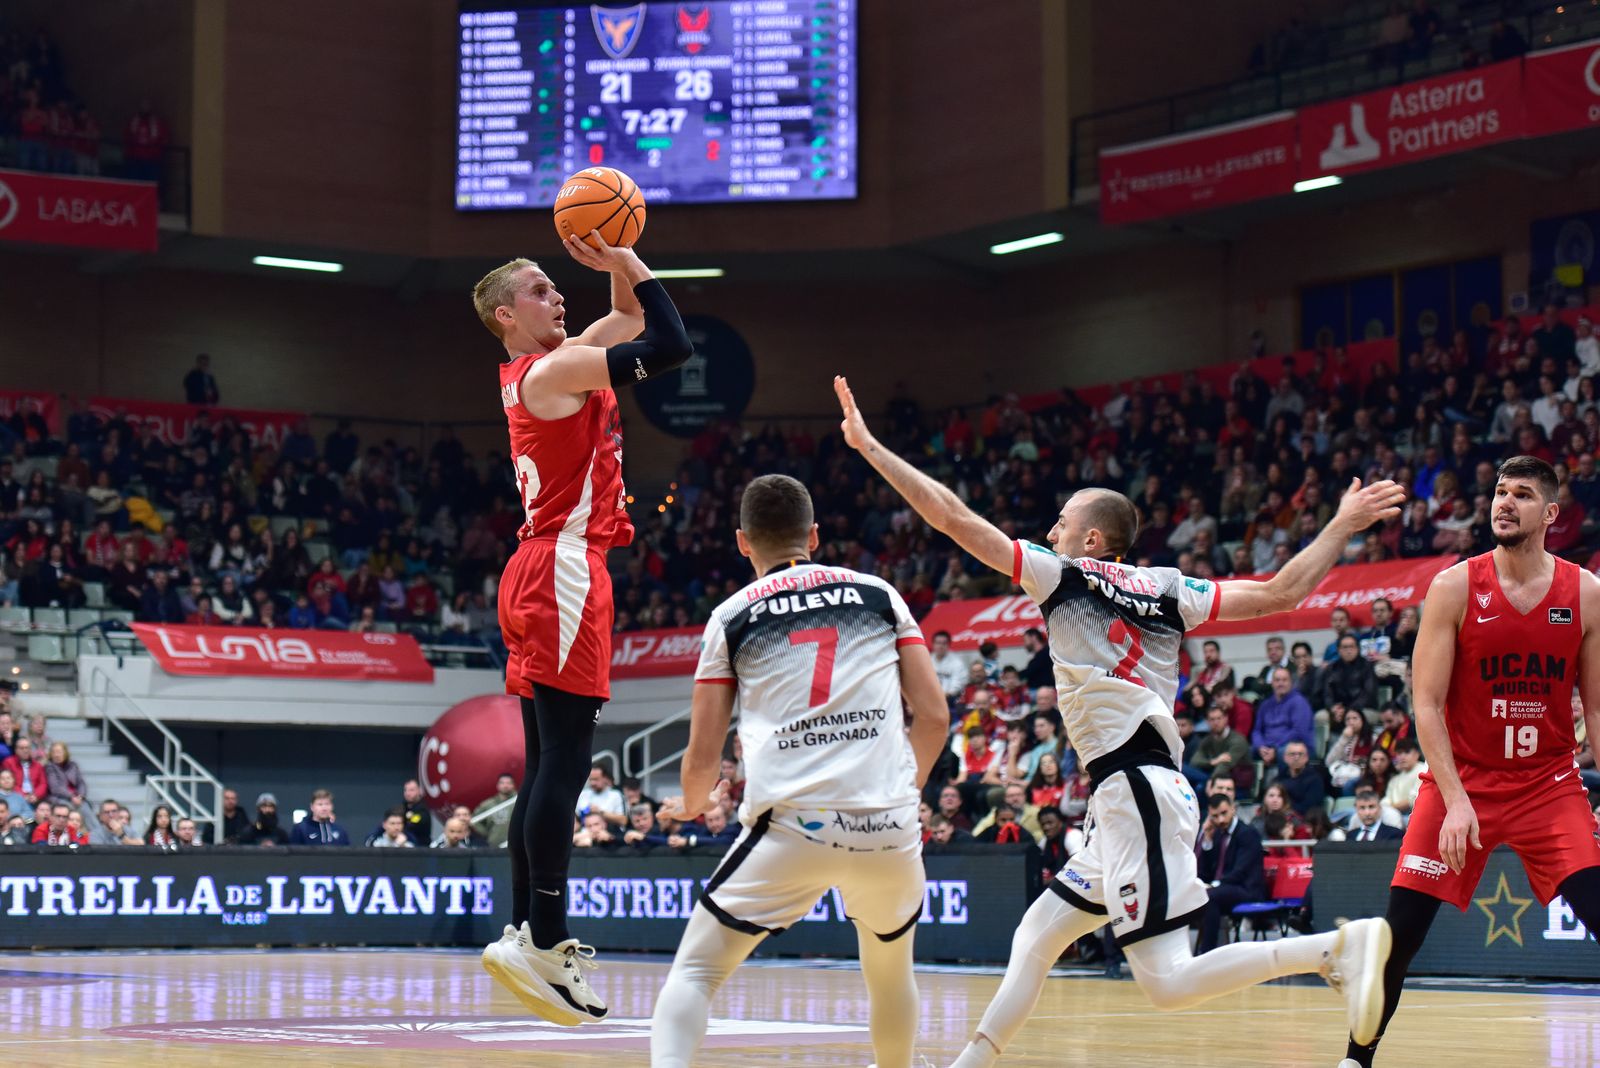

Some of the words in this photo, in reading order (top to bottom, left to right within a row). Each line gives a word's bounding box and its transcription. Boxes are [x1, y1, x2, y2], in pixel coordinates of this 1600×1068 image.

[600, 72, 632, 103] 21
[675, 69, 713, 101] 26
[1388, 77, 1485, 120] Asterra
[621, 107, 688, 135] 7:27
[1388, 108, 1500, 155] Partners
[647, 148, 662, 168] 2
[38, 195, 138, 227] LABASA
[749, 587, 864, 623] PULEVA
[788, 627, 839, 708] 7
[1108, 617, 1148, 688] 2
[1481, 652, 1566, 682] UCAM
[774, 709, 886, 734] UNTAMIENTO
[778, 739, 800, 750] DE
[803, 728, 879, 746] GRANADA
[1505, 726, 1538, 759] 19
[1399, 867, 1439, 880] SOLUTIONS
[1410, 855, 1449, 877] ESP
[0, 876, 224, 915] TRELLA
[225, 885, 262, 905] DE
[266, 876, 493, 915] LEVANTE
[567, 878, 706, 918] ESTREL
